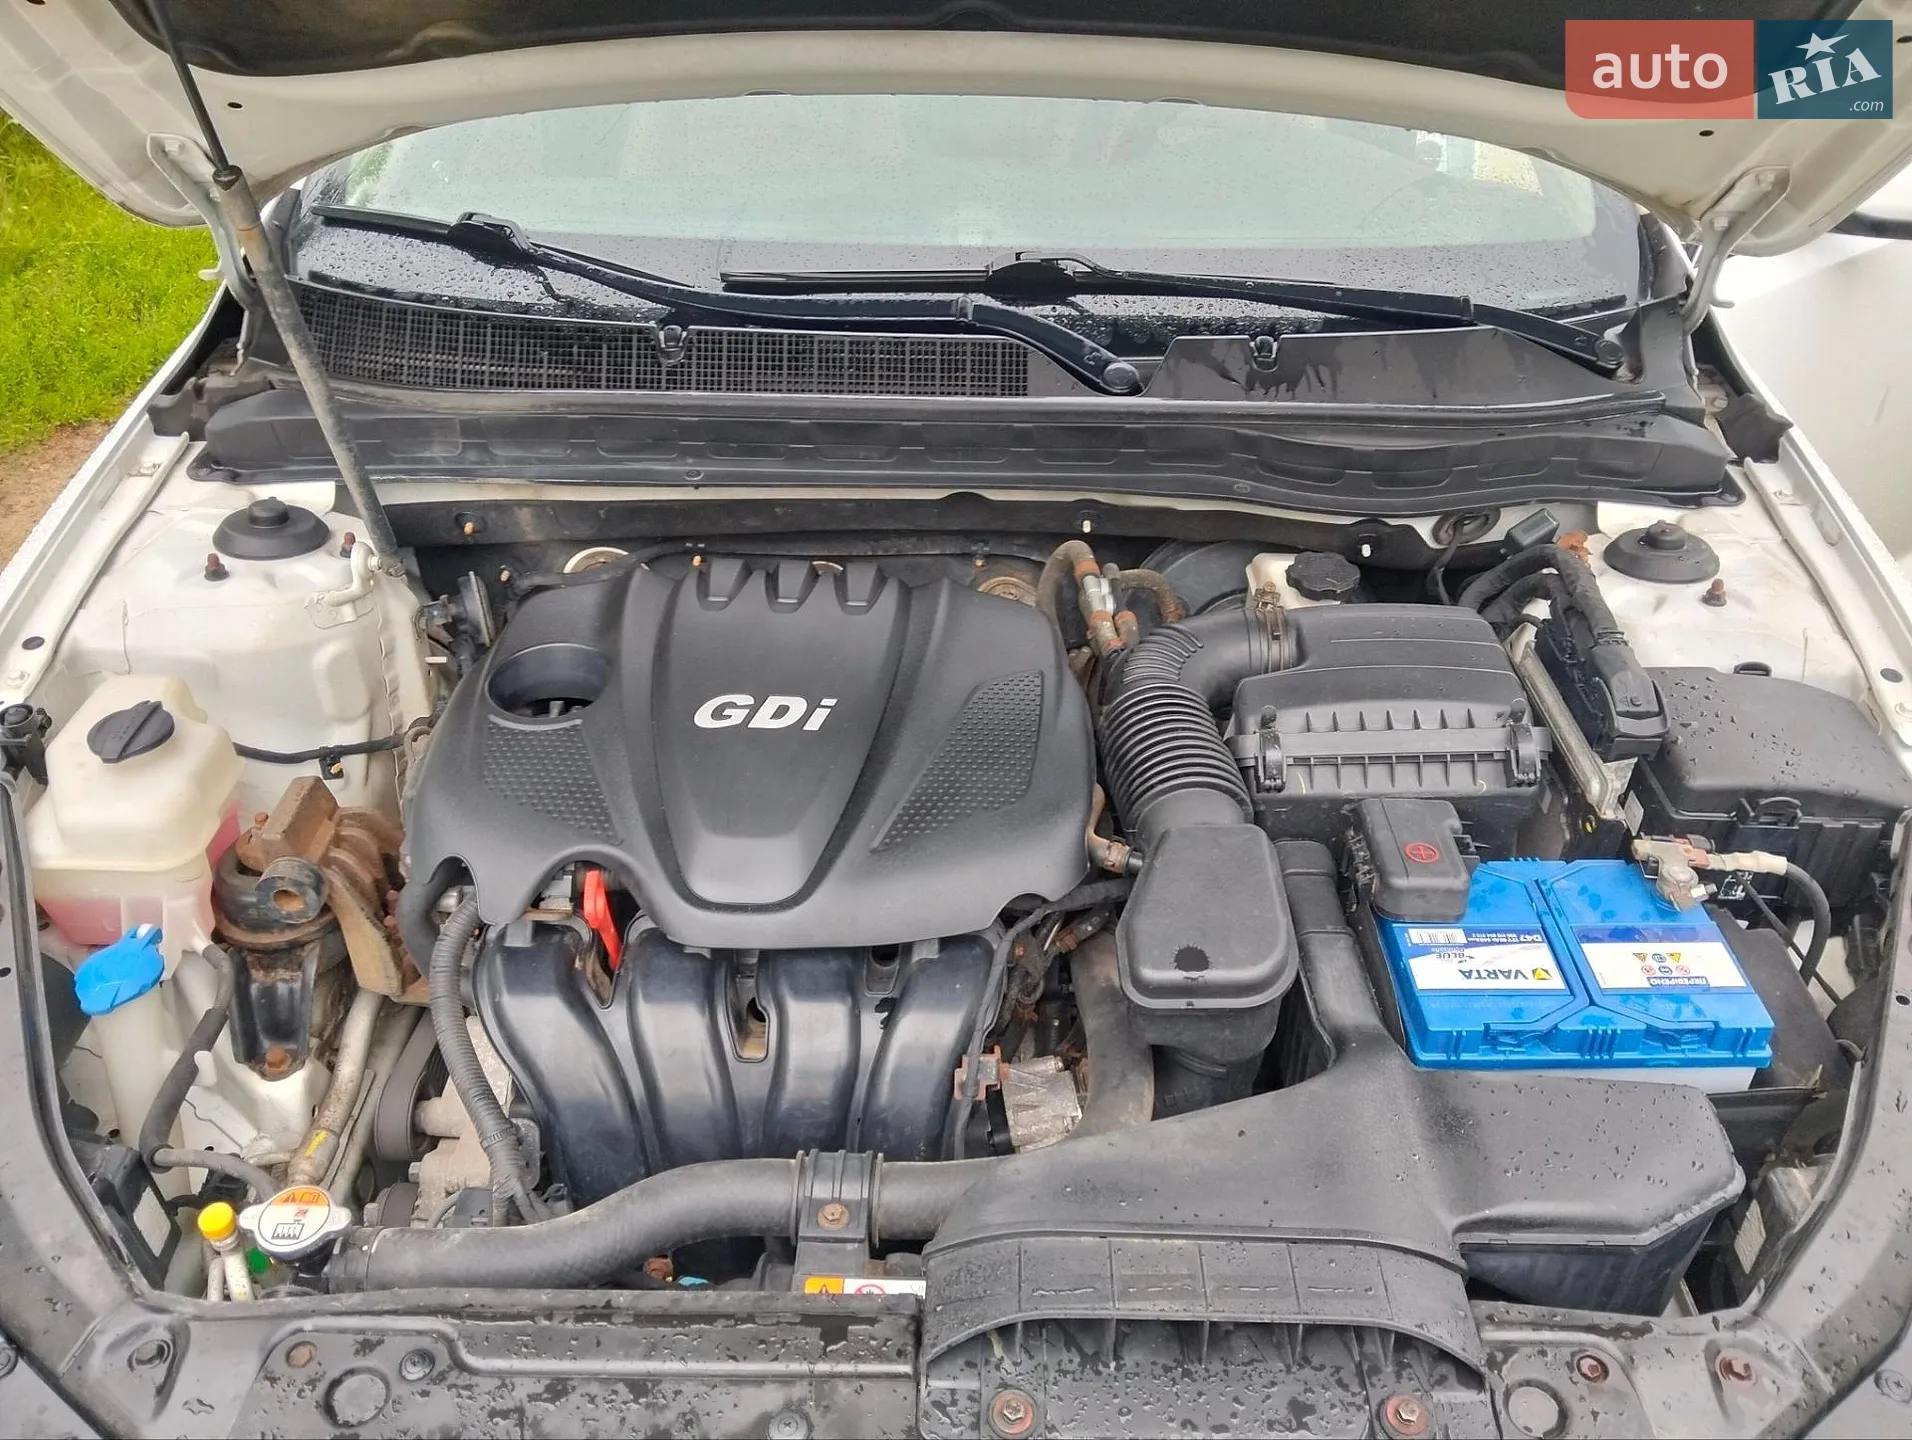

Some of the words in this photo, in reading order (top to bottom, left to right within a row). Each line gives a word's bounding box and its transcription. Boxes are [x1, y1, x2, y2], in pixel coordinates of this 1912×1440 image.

[694, 694, 838, 731] GDi
[1520, 934, 1542, 942] D47
[1458, 969, 1528, 980] VARTA
